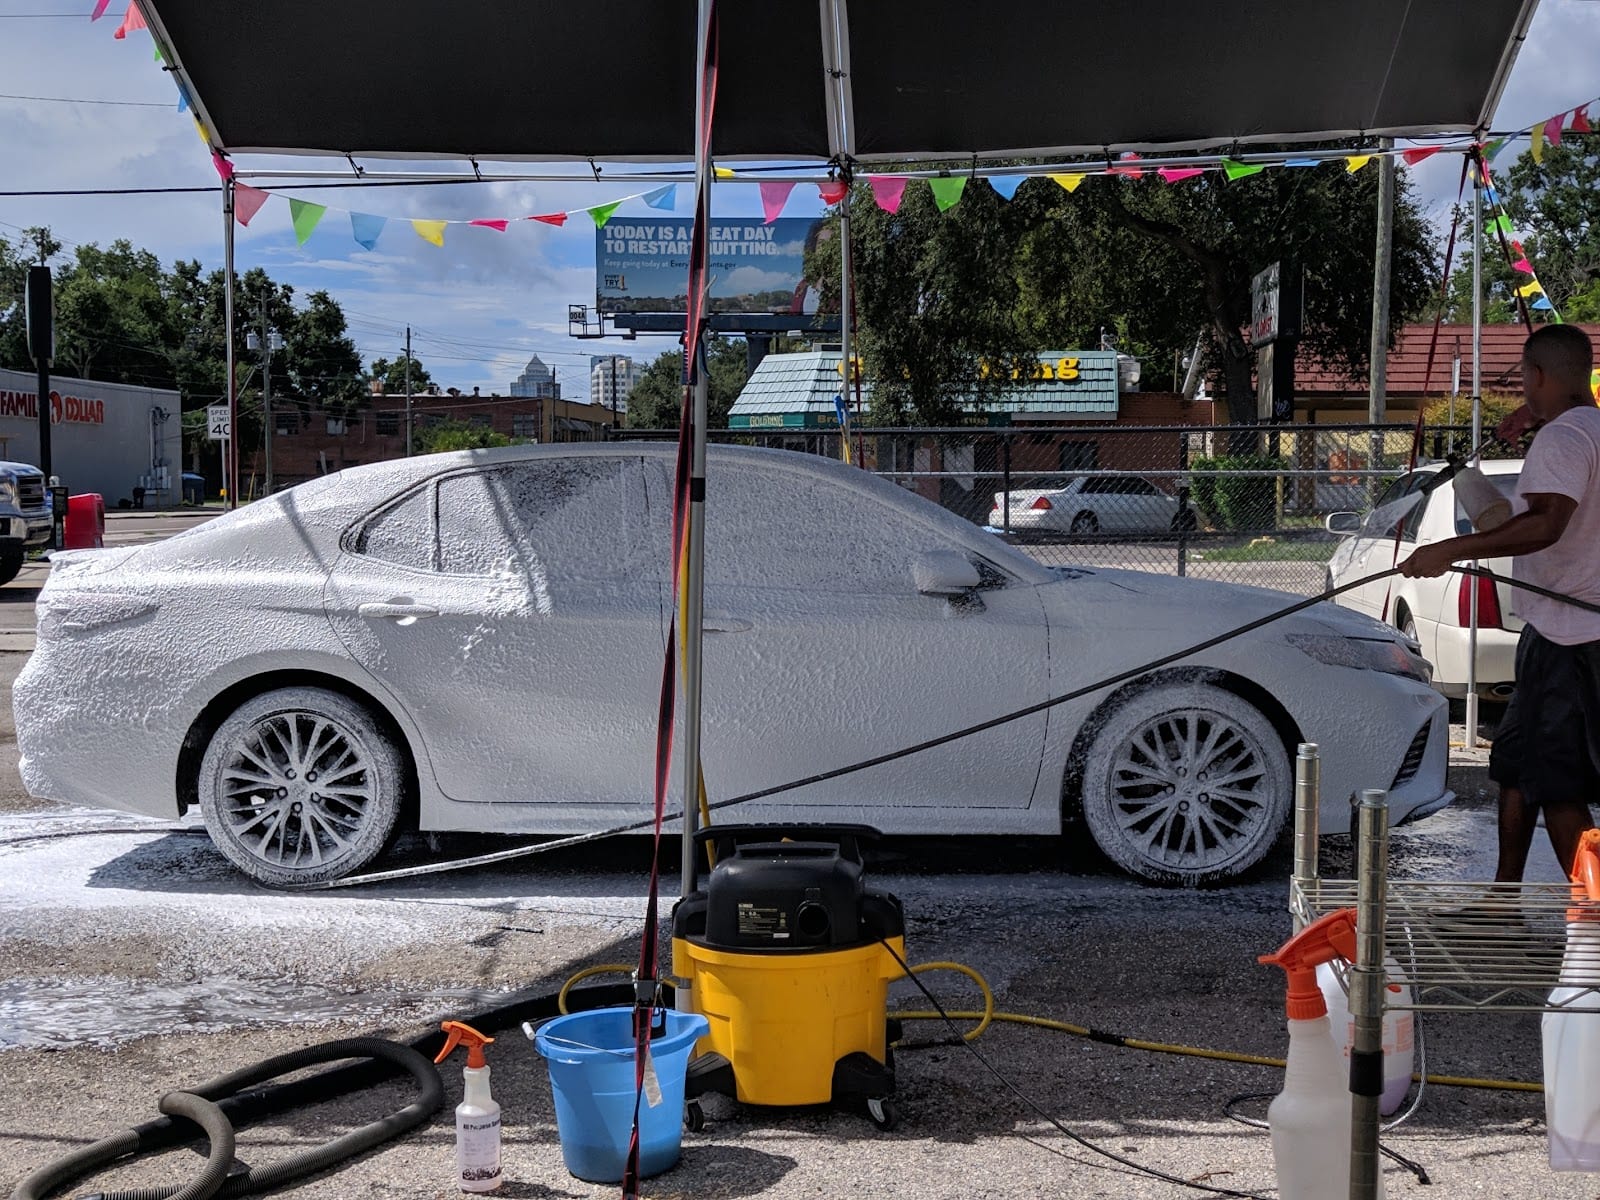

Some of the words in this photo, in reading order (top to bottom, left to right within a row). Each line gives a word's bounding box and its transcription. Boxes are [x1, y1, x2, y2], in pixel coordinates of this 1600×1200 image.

[604, 225, 656, 240] TODAY
[658, 226, 674, 240] IS
[676, 226, 688, 240] A
[690, 226, 741, 241] EAT
[744, 226, 776, 241] DAY
[604, 239, 625, 254] TO
[709, 241, 780, 256] UITTING.
[605, 279, 620, 287] TRY
[0, 390, 39, 418] FAMIL
